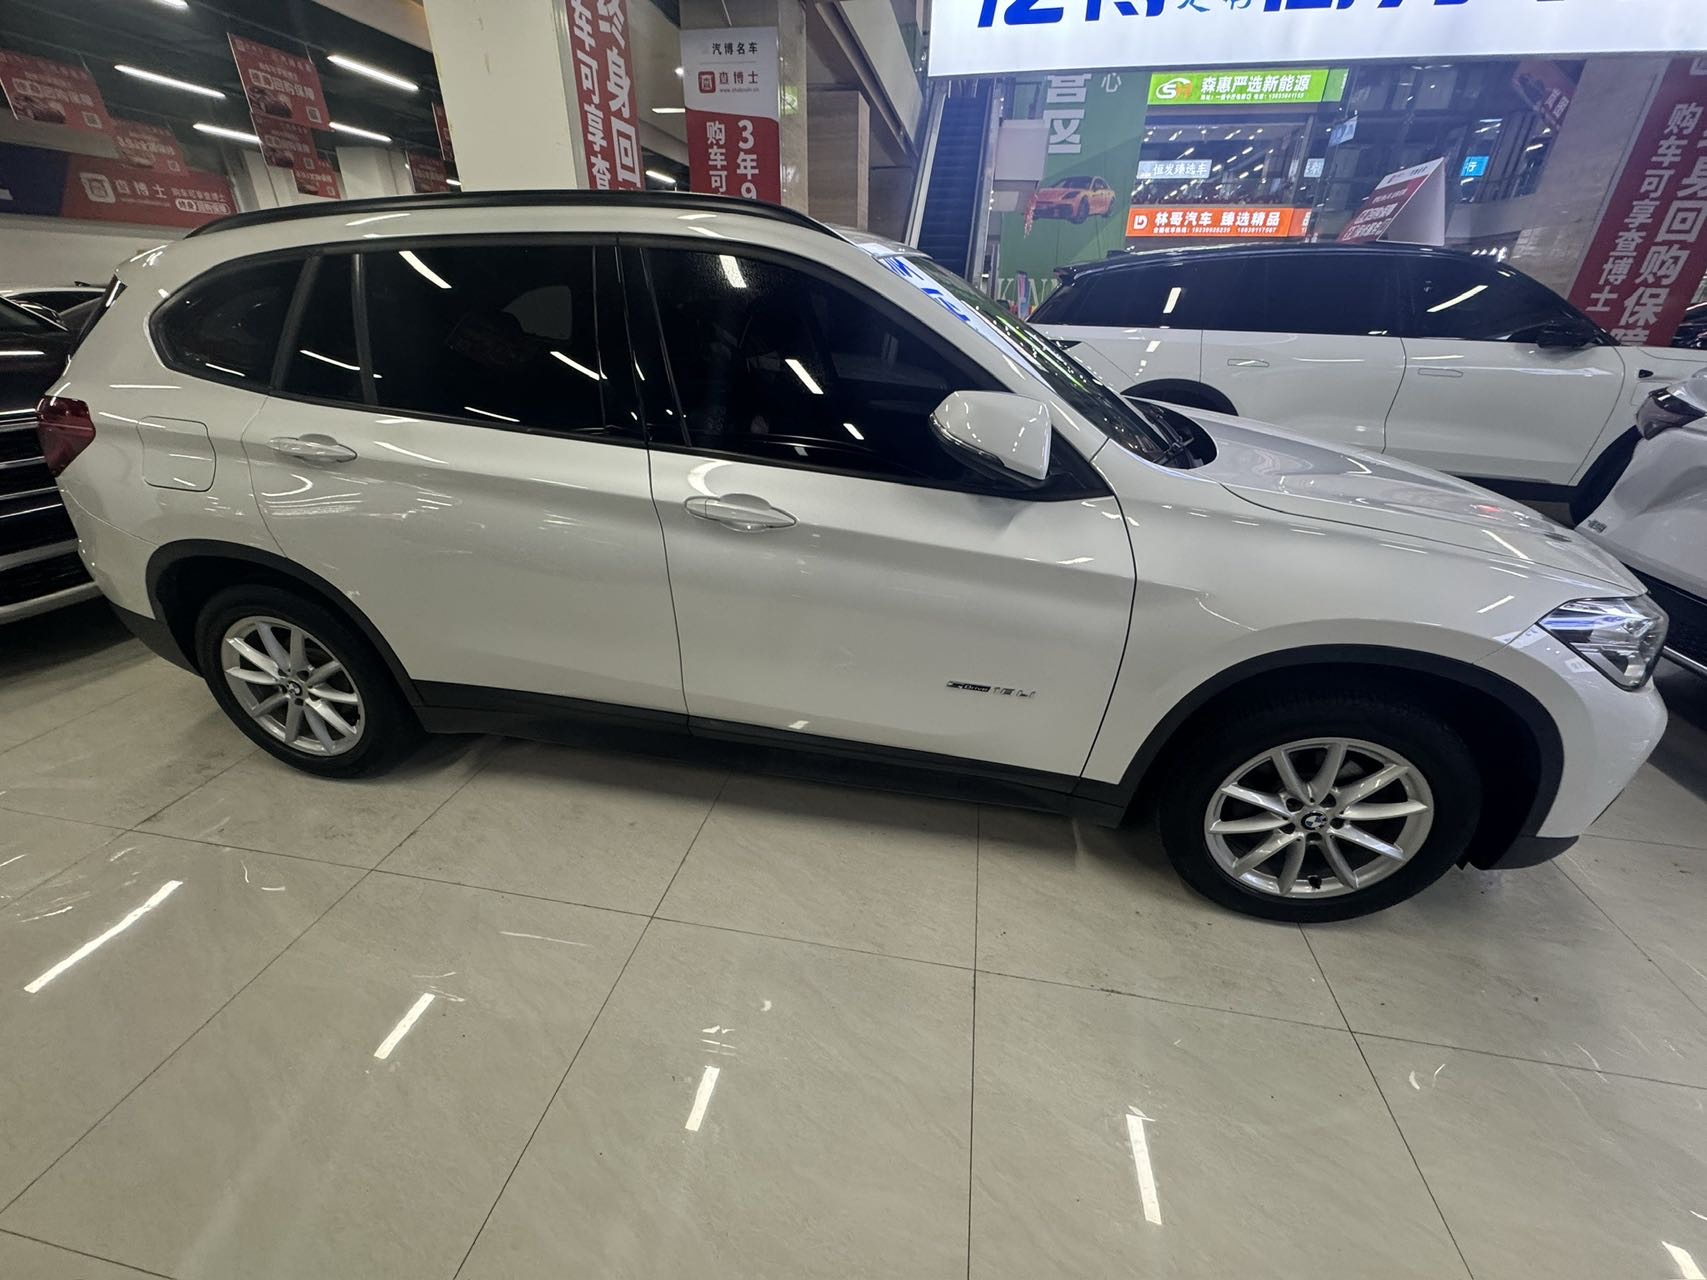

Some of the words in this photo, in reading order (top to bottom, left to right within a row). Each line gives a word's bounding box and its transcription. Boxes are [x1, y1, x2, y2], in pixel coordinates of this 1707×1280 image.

[712, 42, 758, 55] 汽博名车
[1201, 74, 1311, 93] 森惠严选新能源
[597, 0, 641, 190] 终身回
[706, 121, 728, 194] 购车可
[1155, 211, 1212, 226] 林哥汽车
[1220, 211, 1281, 226] 臻选精品
[1585, 103, 1704, 312] 购车可享查博士
[1609, 130, 1707, 346] 身回购保
